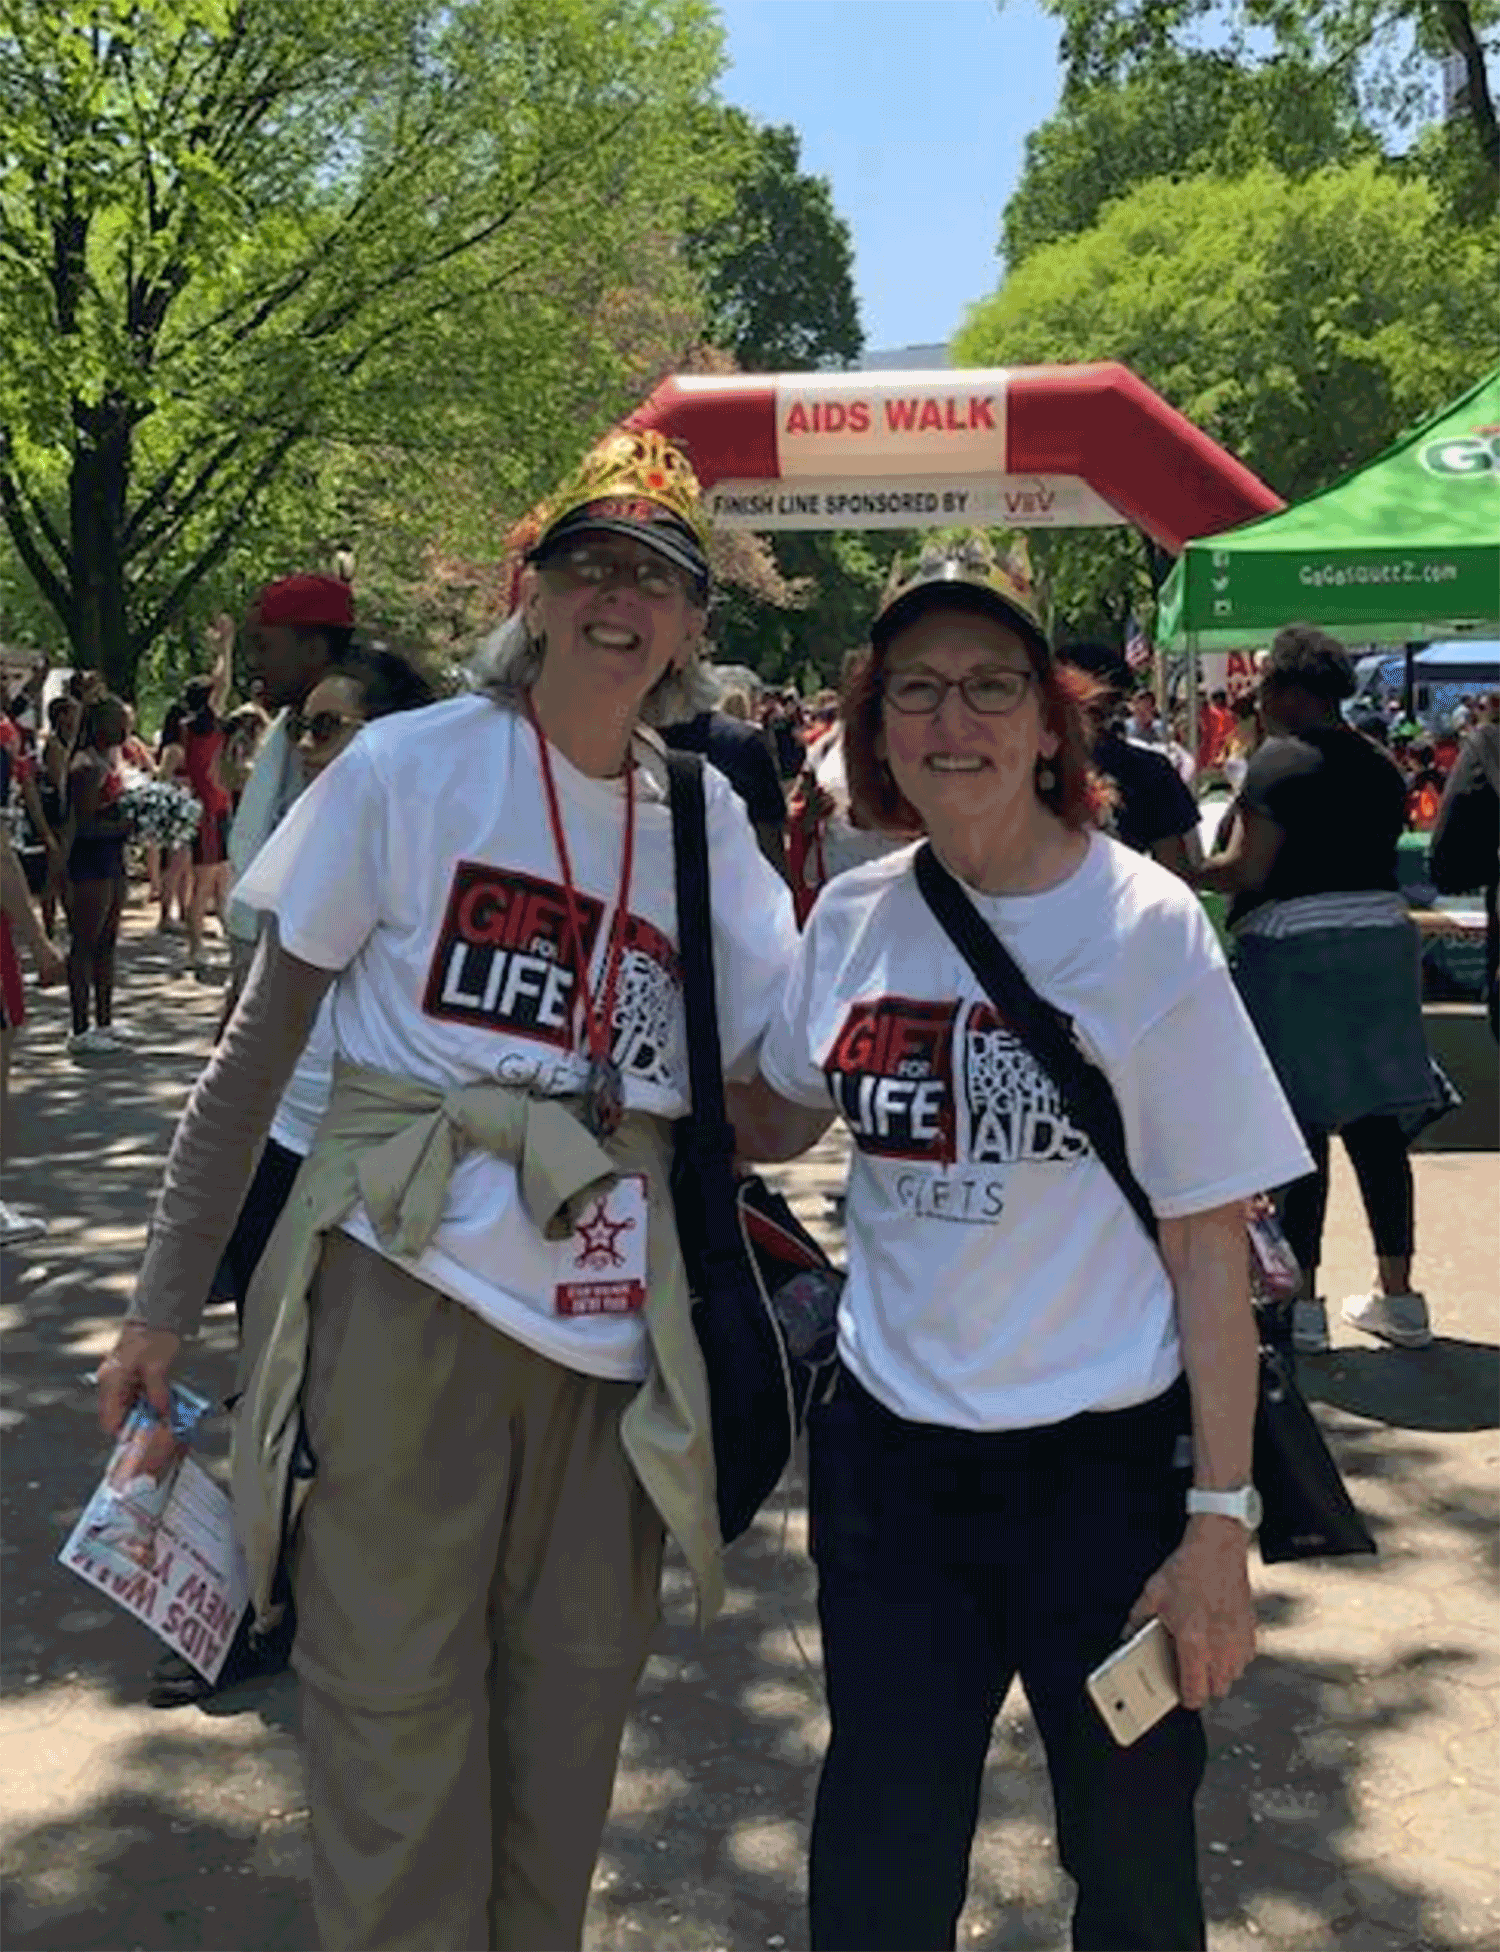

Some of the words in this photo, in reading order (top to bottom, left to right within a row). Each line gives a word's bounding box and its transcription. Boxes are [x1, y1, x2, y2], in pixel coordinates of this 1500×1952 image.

[785, 402, 870, 433] AIDS
[886, 396, 996, 431] WALK
[713, 495, 773, 515] FINISH
[778, 494, 819, 515] LINE
[826, 492, 939, 514] SPONSORED
[942, 491, 969, 513] BY
[458, 882, 592, 963] GIFT
[441, 941, 574, 1028] LIFE
[838, 1014, 947, 1076] GIFT
[832, 1072, 946, 1139] LIFE
[973, 1113, 1090, 1158] AIDS
[161, 1603, 223, 1672] AIDS
[177, 1573, 238, 1643] NEW
